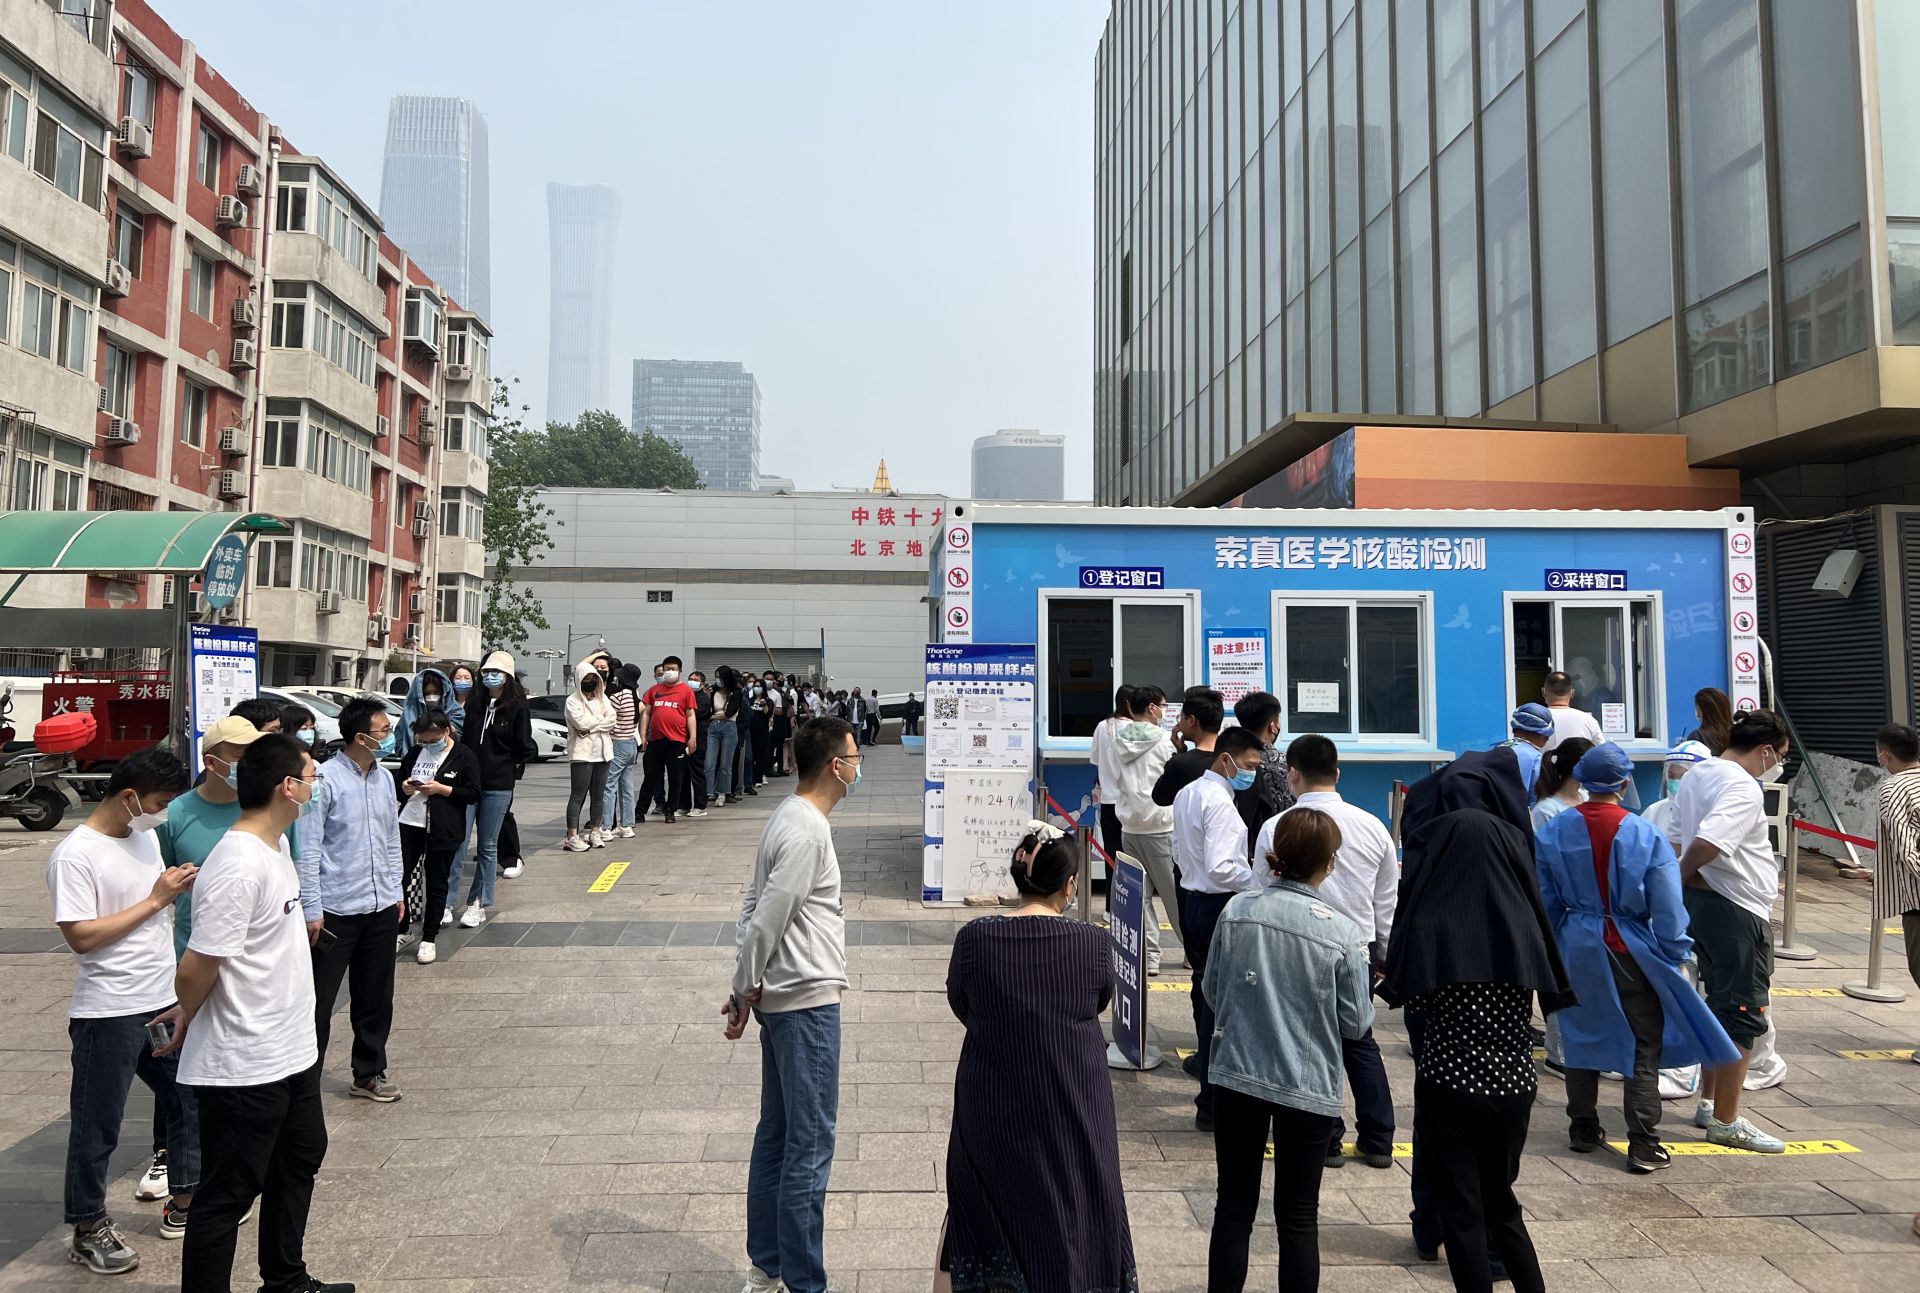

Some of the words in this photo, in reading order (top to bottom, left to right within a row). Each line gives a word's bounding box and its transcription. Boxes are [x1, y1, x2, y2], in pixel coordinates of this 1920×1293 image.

[215, 545, 243, 563] 外卖车
[850, 539, 923, 557] 北京地
[1215, 536, 1487, 570] 索真医学核酸检测
[215, 563, 236, 580] 临时
[207, 580, 236, 598] 停放处
[193, 637, 256, 653] 核酸检测采样点
[926, 647, 963, 655] ThorGene
[926, 662, 1036, 676] 核酸检测采样点
[119, 683, 171, 700] 秀水街
[956, 687, 1005, 695] 登记缴费流程
[52, 695, 95, 715] 火警
[1114, 983, 1131, 1031] 入口
